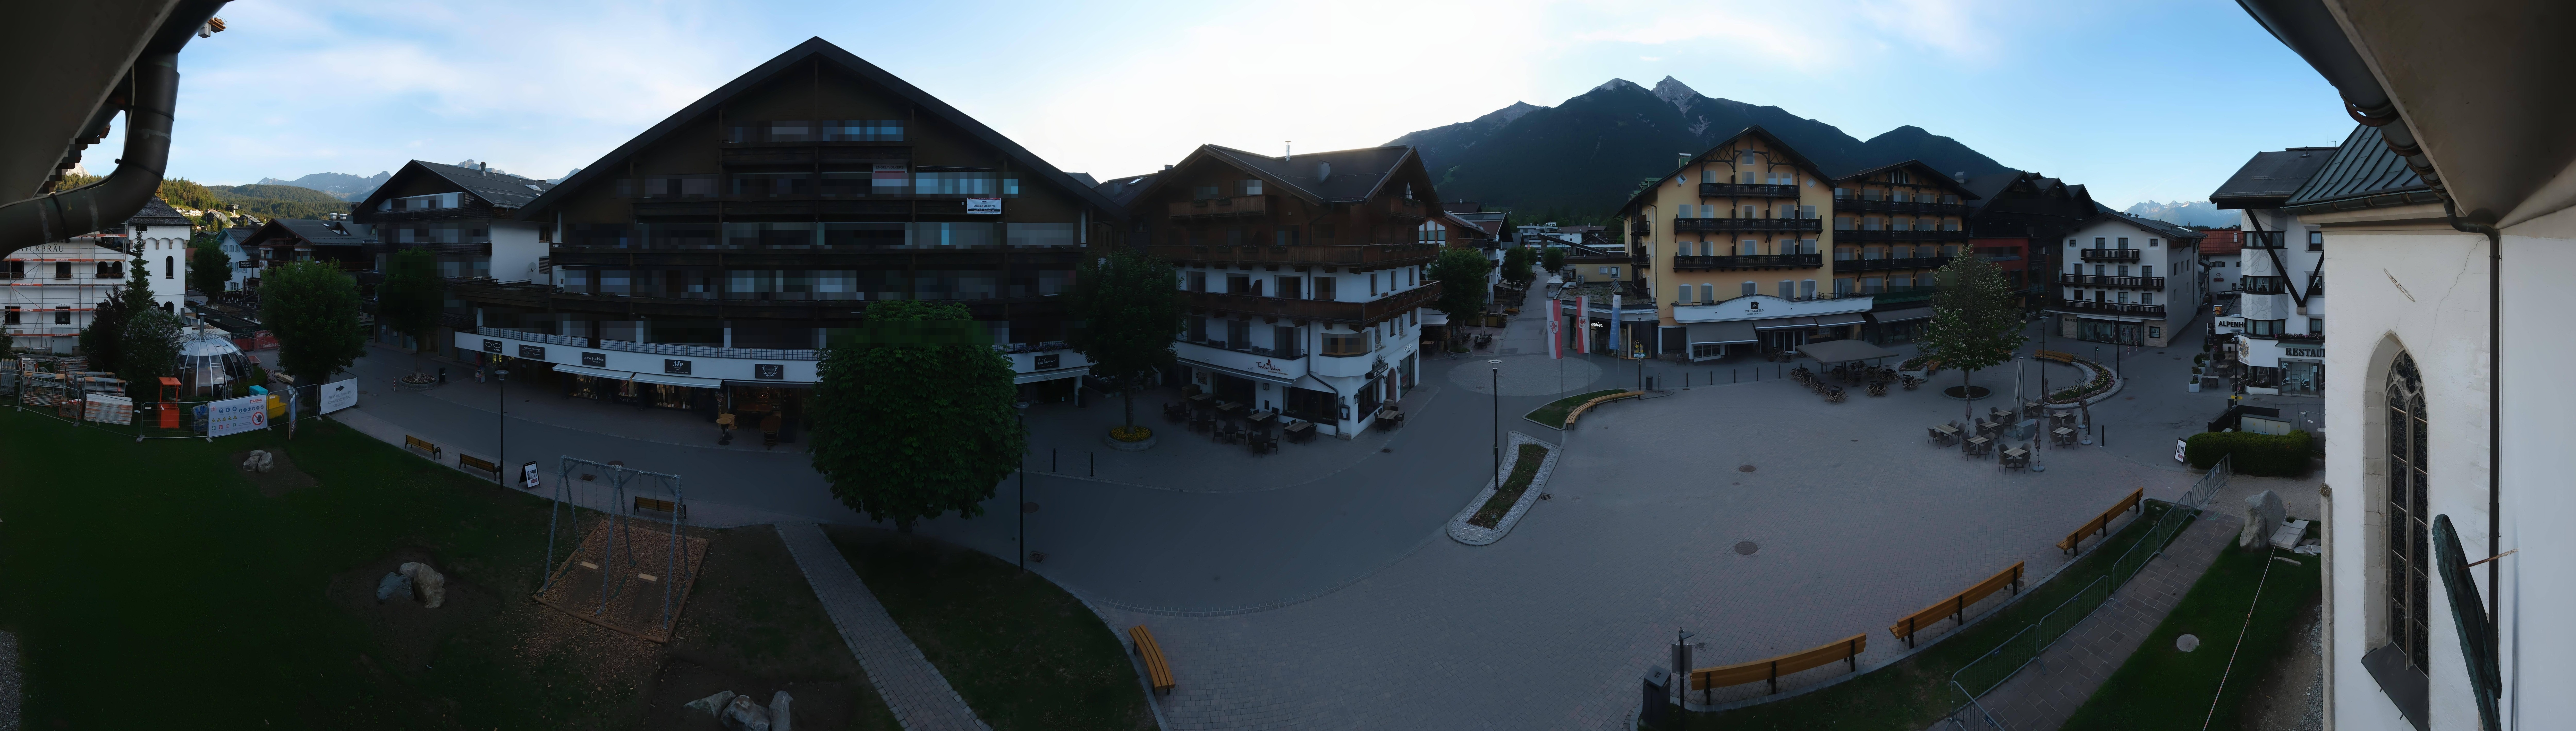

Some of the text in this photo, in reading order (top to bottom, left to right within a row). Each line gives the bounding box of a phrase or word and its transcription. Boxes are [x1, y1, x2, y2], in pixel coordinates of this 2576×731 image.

[672, 361, 683, 370] My
[1374, 364, 1387, 377] RESTAURANT
[328, 395, 351, 404] KONGRESSZENTRUM
